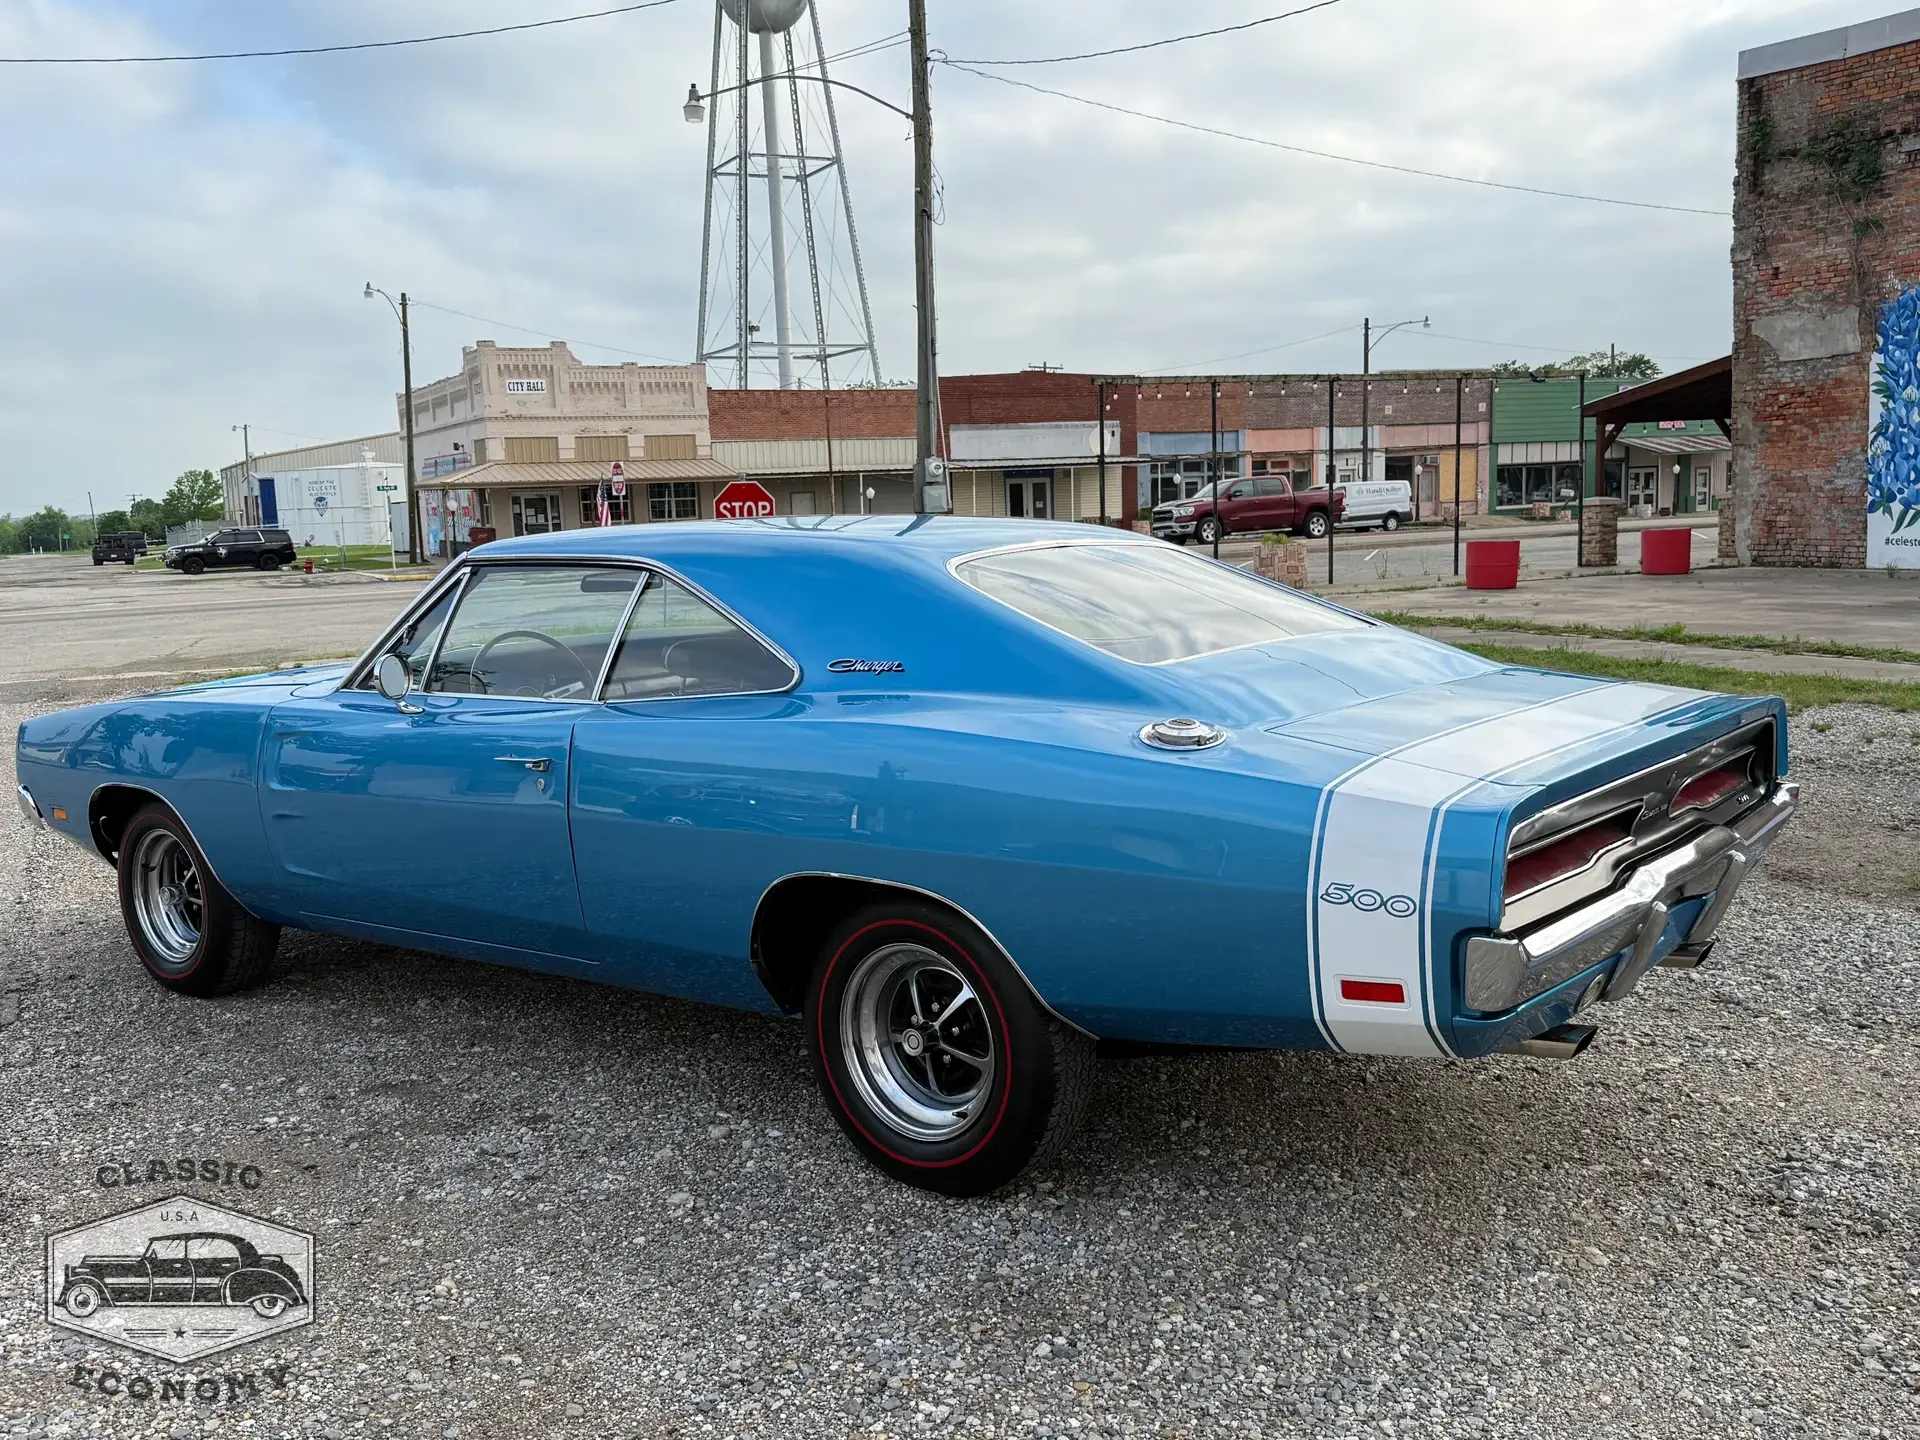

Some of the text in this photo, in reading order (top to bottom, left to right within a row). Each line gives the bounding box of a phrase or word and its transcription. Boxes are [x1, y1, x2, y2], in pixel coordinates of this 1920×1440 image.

[507, 381, 546, 392] CITY HALL
[719, 501, 771, 519] STOP
[826, 658, 905, 676] Charger
[1320, 882, 1417, 918] 500
